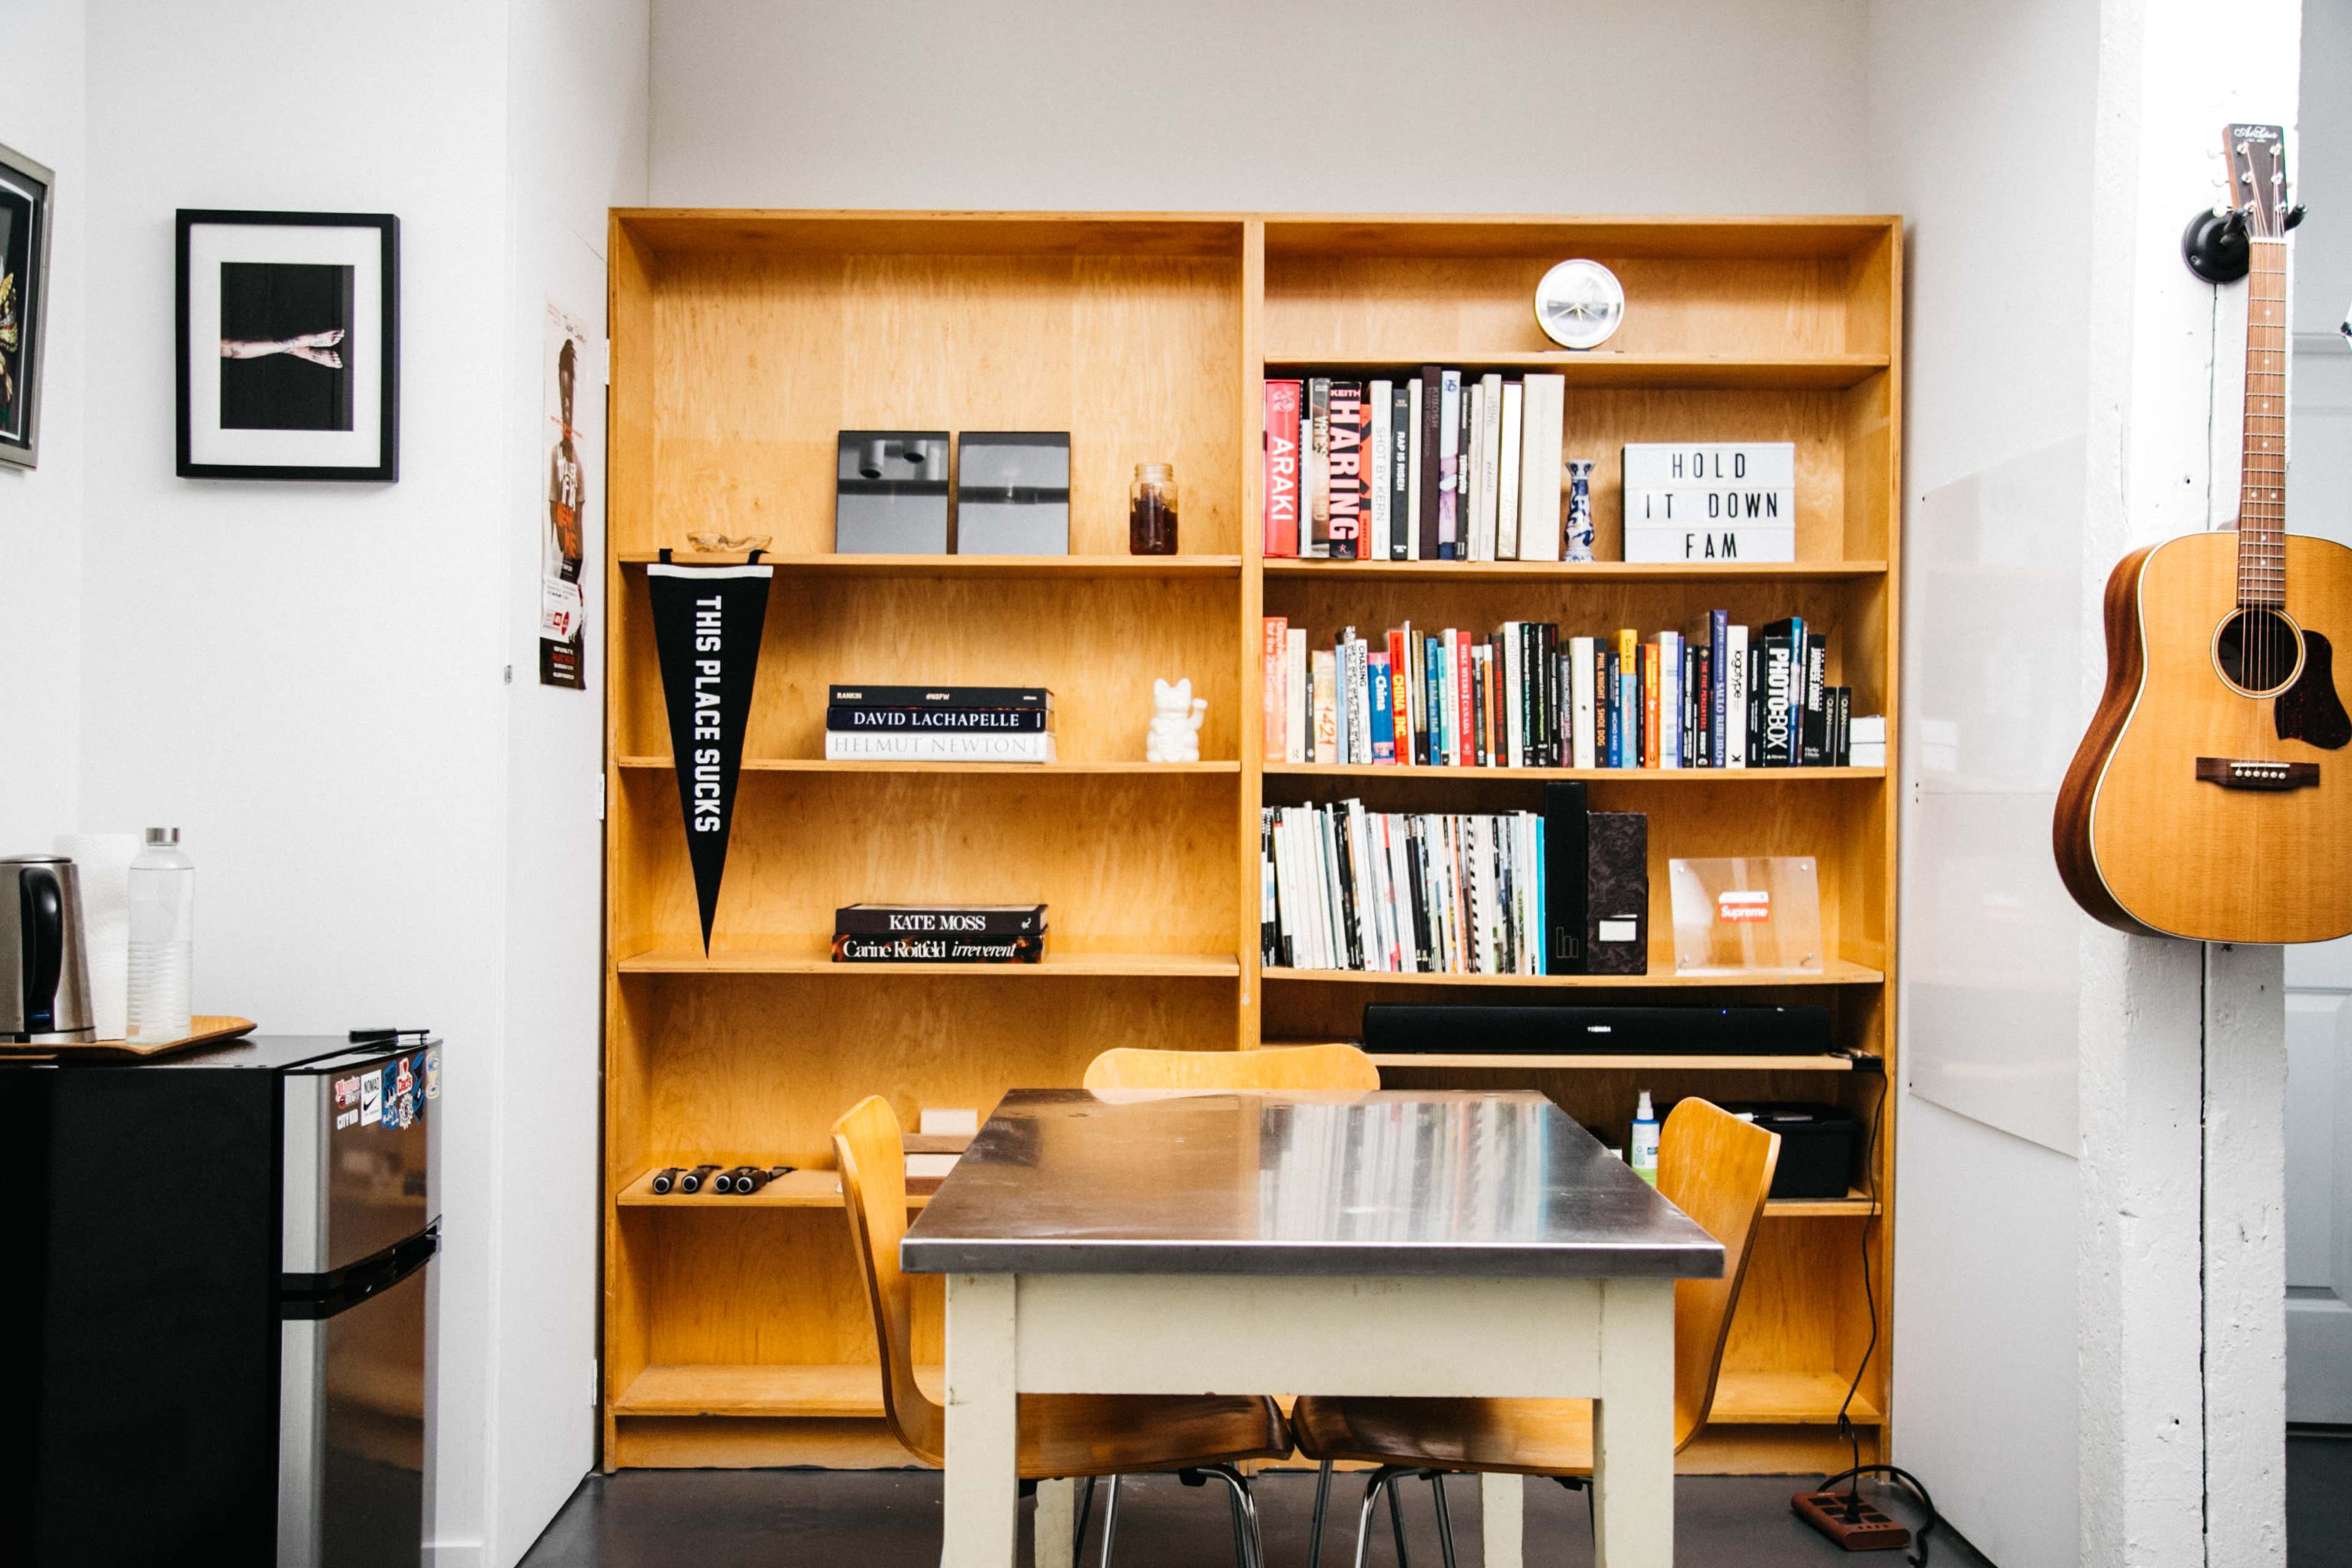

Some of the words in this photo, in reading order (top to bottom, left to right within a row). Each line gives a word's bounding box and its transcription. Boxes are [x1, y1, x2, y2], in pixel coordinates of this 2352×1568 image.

[1330, 389, 1360, 398] KEITH
[1431, 386, 1439, 428] KIBOSH
[1376, 426, 1386, 459] SHOT
[1396, 431, 1406, 451] RAP
[1329, 401, 1360, 540] HARING
[1397, 452, 1405, 462] IS
[1672, 453, 1746, 478] HOLD
[1272, 436, 1295, 520] ARAKI
[1376, 465, 1386, 481] BY
[1396, 464, 1405, 491] RISEN
[1375, 486, 1386, 521] KERN
[1646, 494, 1673, 519] IT
[1709, 492, 1777, 518] DOWN
[1686, 533, 1737, 559] FAM
[695, 595, 722, 652] THIS
[1508, 635, 1520, 687] PHOTOSHOP
[1597, 652, 1605, 669] PHIL
[1597, 671, 1605, 699] KNIGHT
[1732, 650, 1744, 699] logotype
[695, 660, 721, 741] PLACE
[836, 692, 862, 700] RANKIN
[925, 693, 950, 701] #NSFW
[1376, 675, 1387, 711] China
[1393, 674, 1406, 712] CHINA
[1716, 682, 1725, 713] SAULO
[1766, 647, 1790, 749] PHOTO:BOX
[854, 712, 906, 726] DAVID
[911, 712, 1020, 728] LACHAPELLE
[1317, 706, 1335, 745] 1421
[1462, 699, 1471, 735] CANADA
[1597, 708, 1605, 728] SHOE
[835, 737, 922, 753] HELMUT
[931, 737, 1026, 753] NEWTON
[1597, 729, 1605, 746] DOG
[1716, 715, 1725, 758] RIBEIRO
[694, 748, 720, 832] SUCKS
[889, 915, 935, 931] KATE
[940, 915, 986, 931] MOSS
[1721, 905, 1768, 919] Supreme
[843, 940, 891, 959] Carine
[894, 940, 946, 959] Roitfeld
[952, 940, 1017, 958] irreverent
